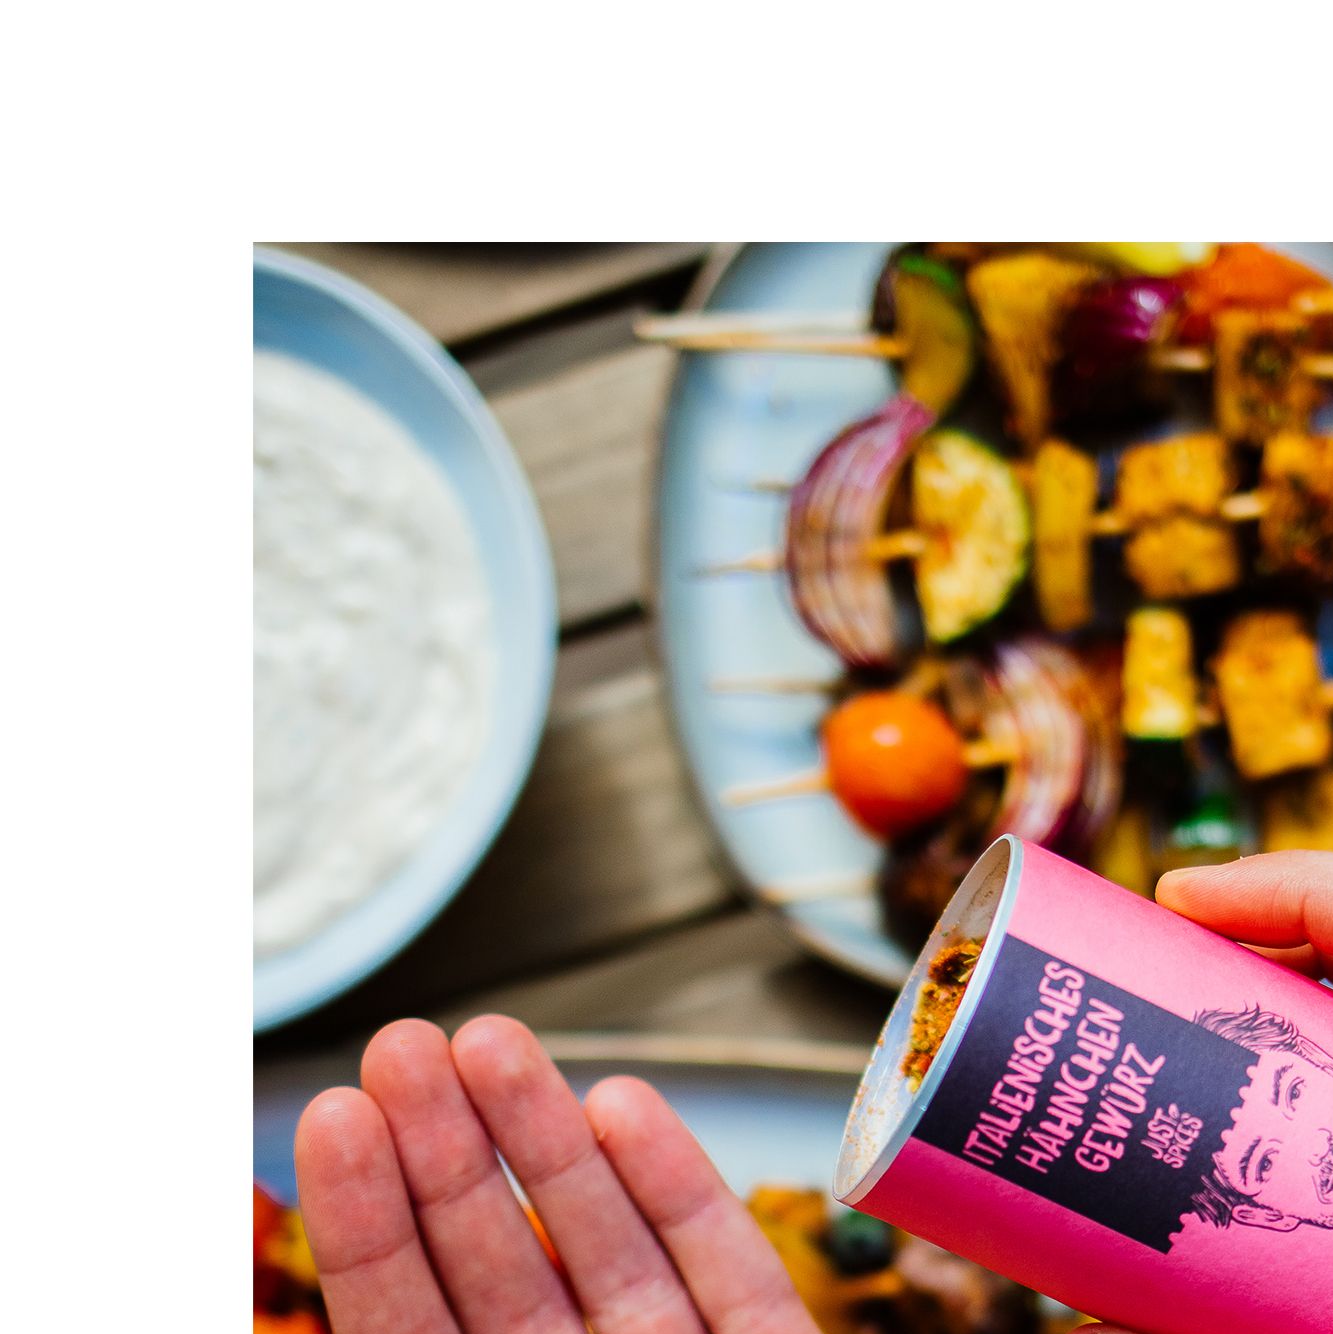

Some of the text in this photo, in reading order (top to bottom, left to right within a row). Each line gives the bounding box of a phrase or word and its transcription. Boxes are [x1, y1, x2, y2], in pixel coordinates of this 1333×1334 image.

[961, 960, 1086, 1166] ITALIENISCHES
[1015, 997, 1125, 1174] HÄHNCHEN
[1074, 1042, 1166, 1173] GEWÜRZ
[1141, 1107, 1177, 1160] JUST
[1163, 1116, 1203, 1168] SPICES
